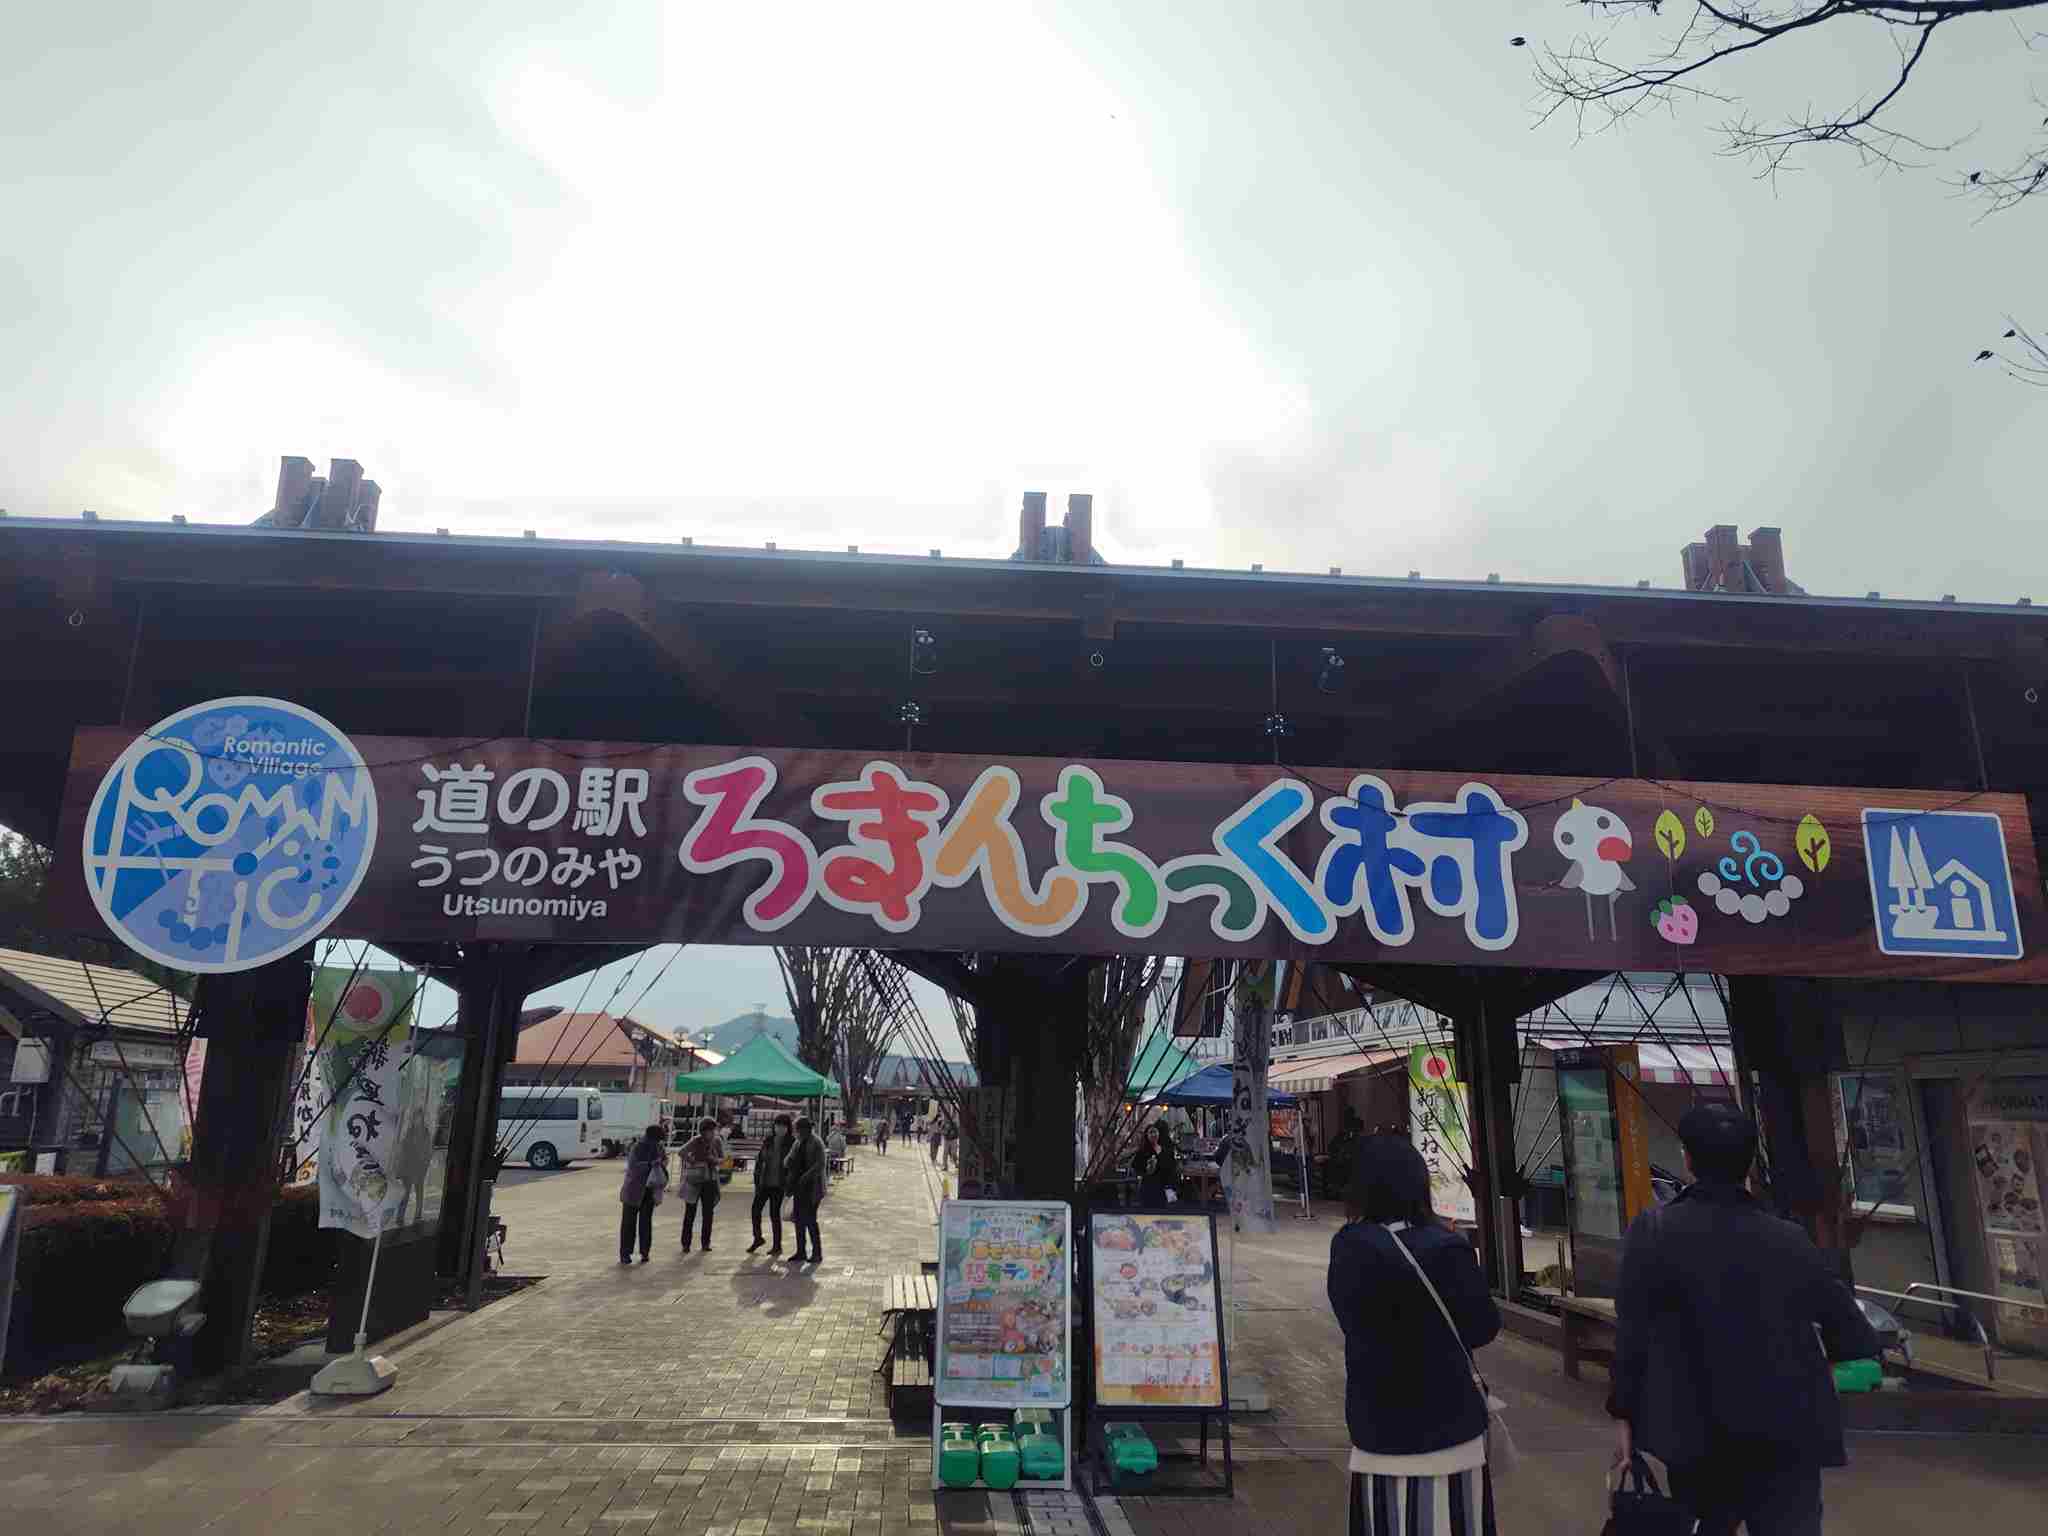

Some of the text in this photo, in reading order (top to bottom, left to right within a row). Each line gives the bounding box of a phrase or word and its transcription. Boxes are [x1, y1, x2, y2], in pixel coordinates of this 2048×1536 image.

[224, 736, 328, 756] Romantic
[249, 757, 322, 778] Village
[412, 763, 649, 837] 道の駅
[411, 844, 642, 889] うつのみや
[679, 755, 1529, 950] ろまんちっく村
[443, 893, 608, 920] Utsunomiya
